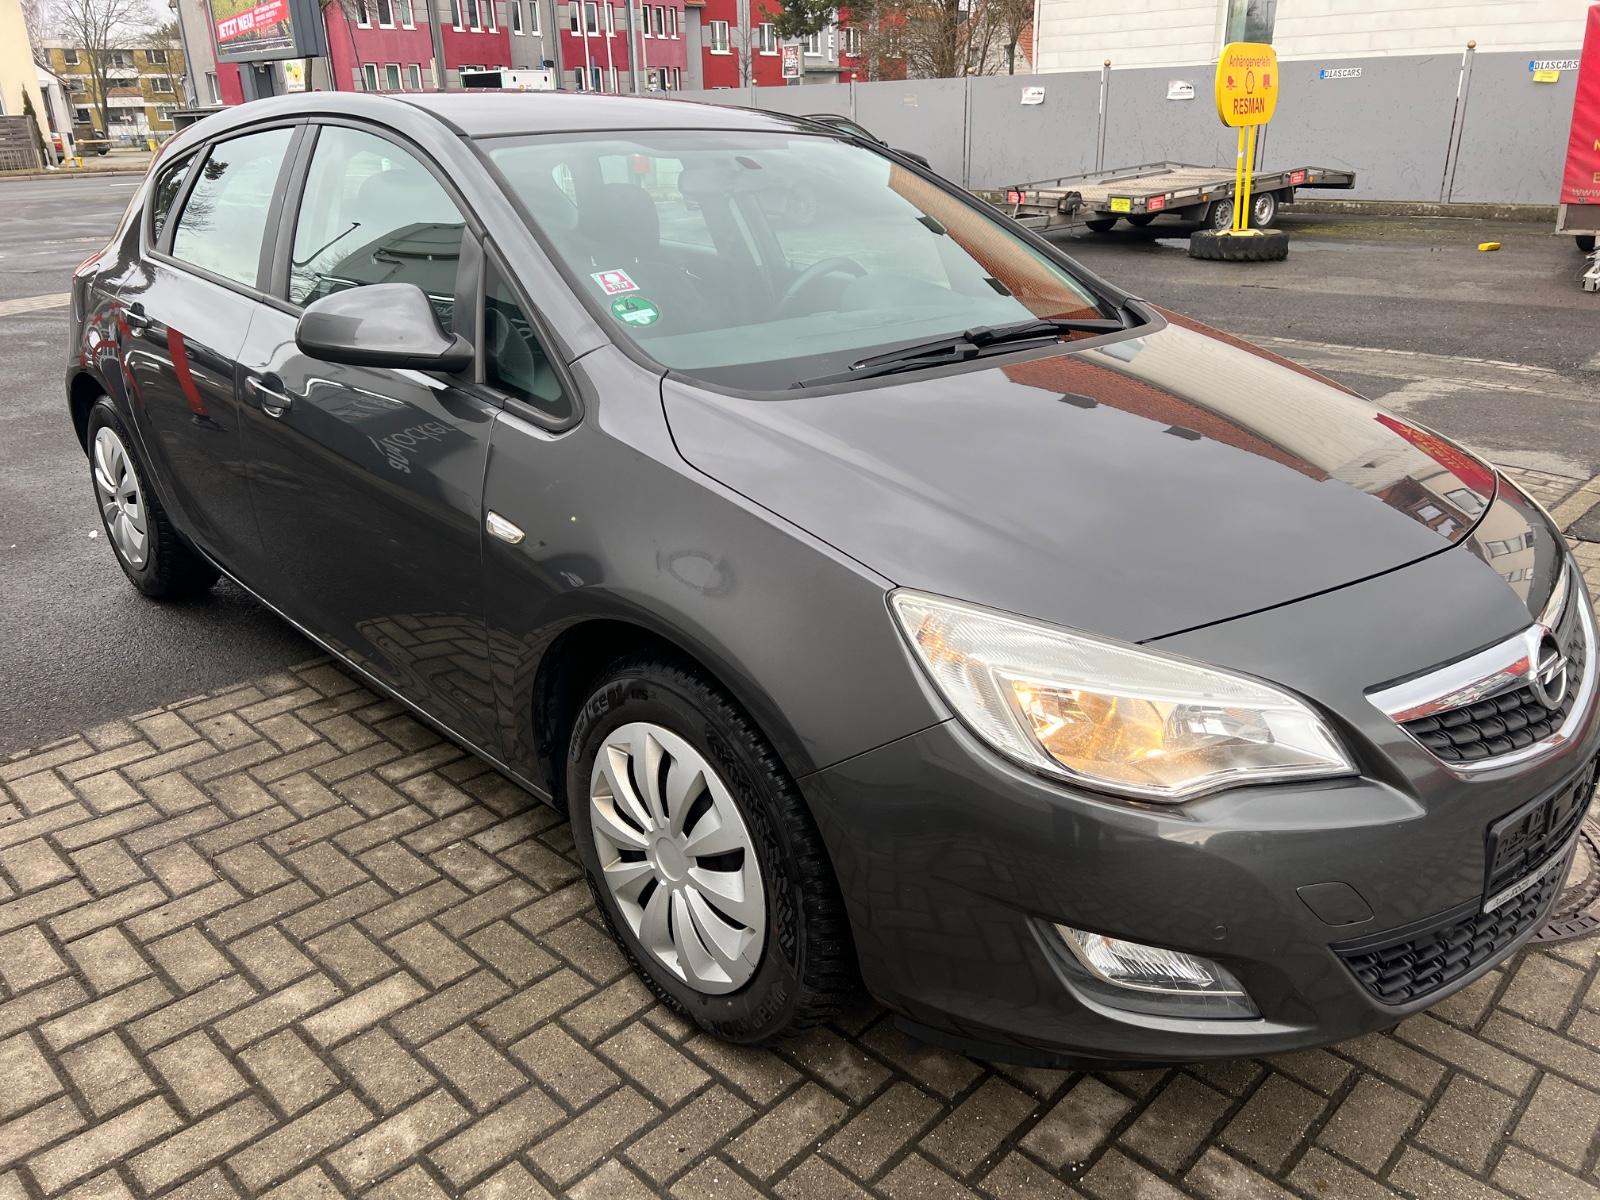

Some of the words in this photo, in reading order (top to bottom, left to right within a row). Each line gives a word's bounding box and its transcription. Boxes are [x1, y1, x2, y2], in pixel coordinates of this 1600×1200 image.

[218, 18, 239, 39] JETZT
[237, 12, 255, 31] NEU!
[1229, 55, 1271, 70] Anhängerverleih
[1233, 97, 1265, 115] RESMAN
